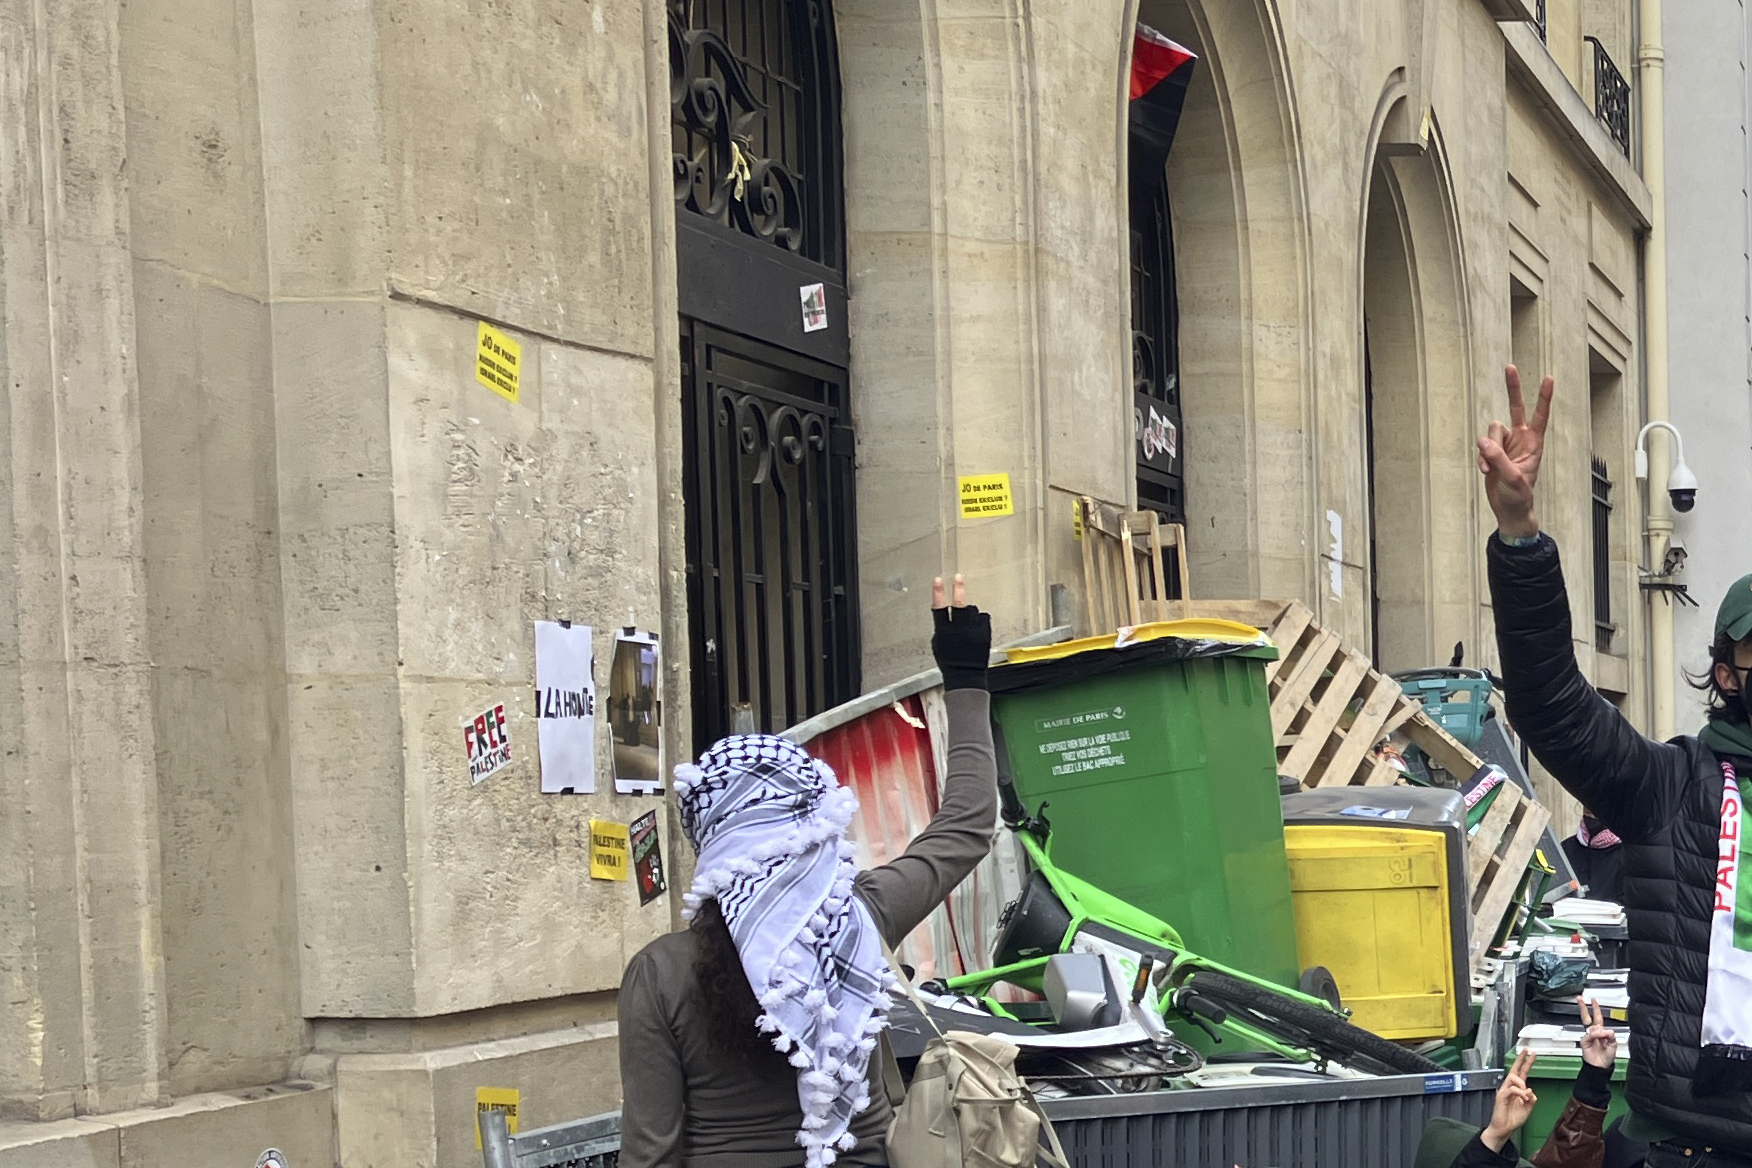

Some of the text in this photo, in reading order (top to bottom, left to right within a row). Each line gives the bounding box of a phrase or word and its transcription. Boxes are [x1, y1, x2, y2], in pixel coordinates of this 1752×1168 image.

[962, 483, 971, 493] JO
[983, 483, 1003, 491] PARIS
[544, 686, 562, 719] LA
[1043, 711, 1108, 729] MAIRIE DE PARIS
[464, 704, 507, 760] FREE
[470, 743, 511, 783] PALESTINE
[593, 834, 626, 850] PALESTINE
[595, 854, 617, 867] VIVRA
